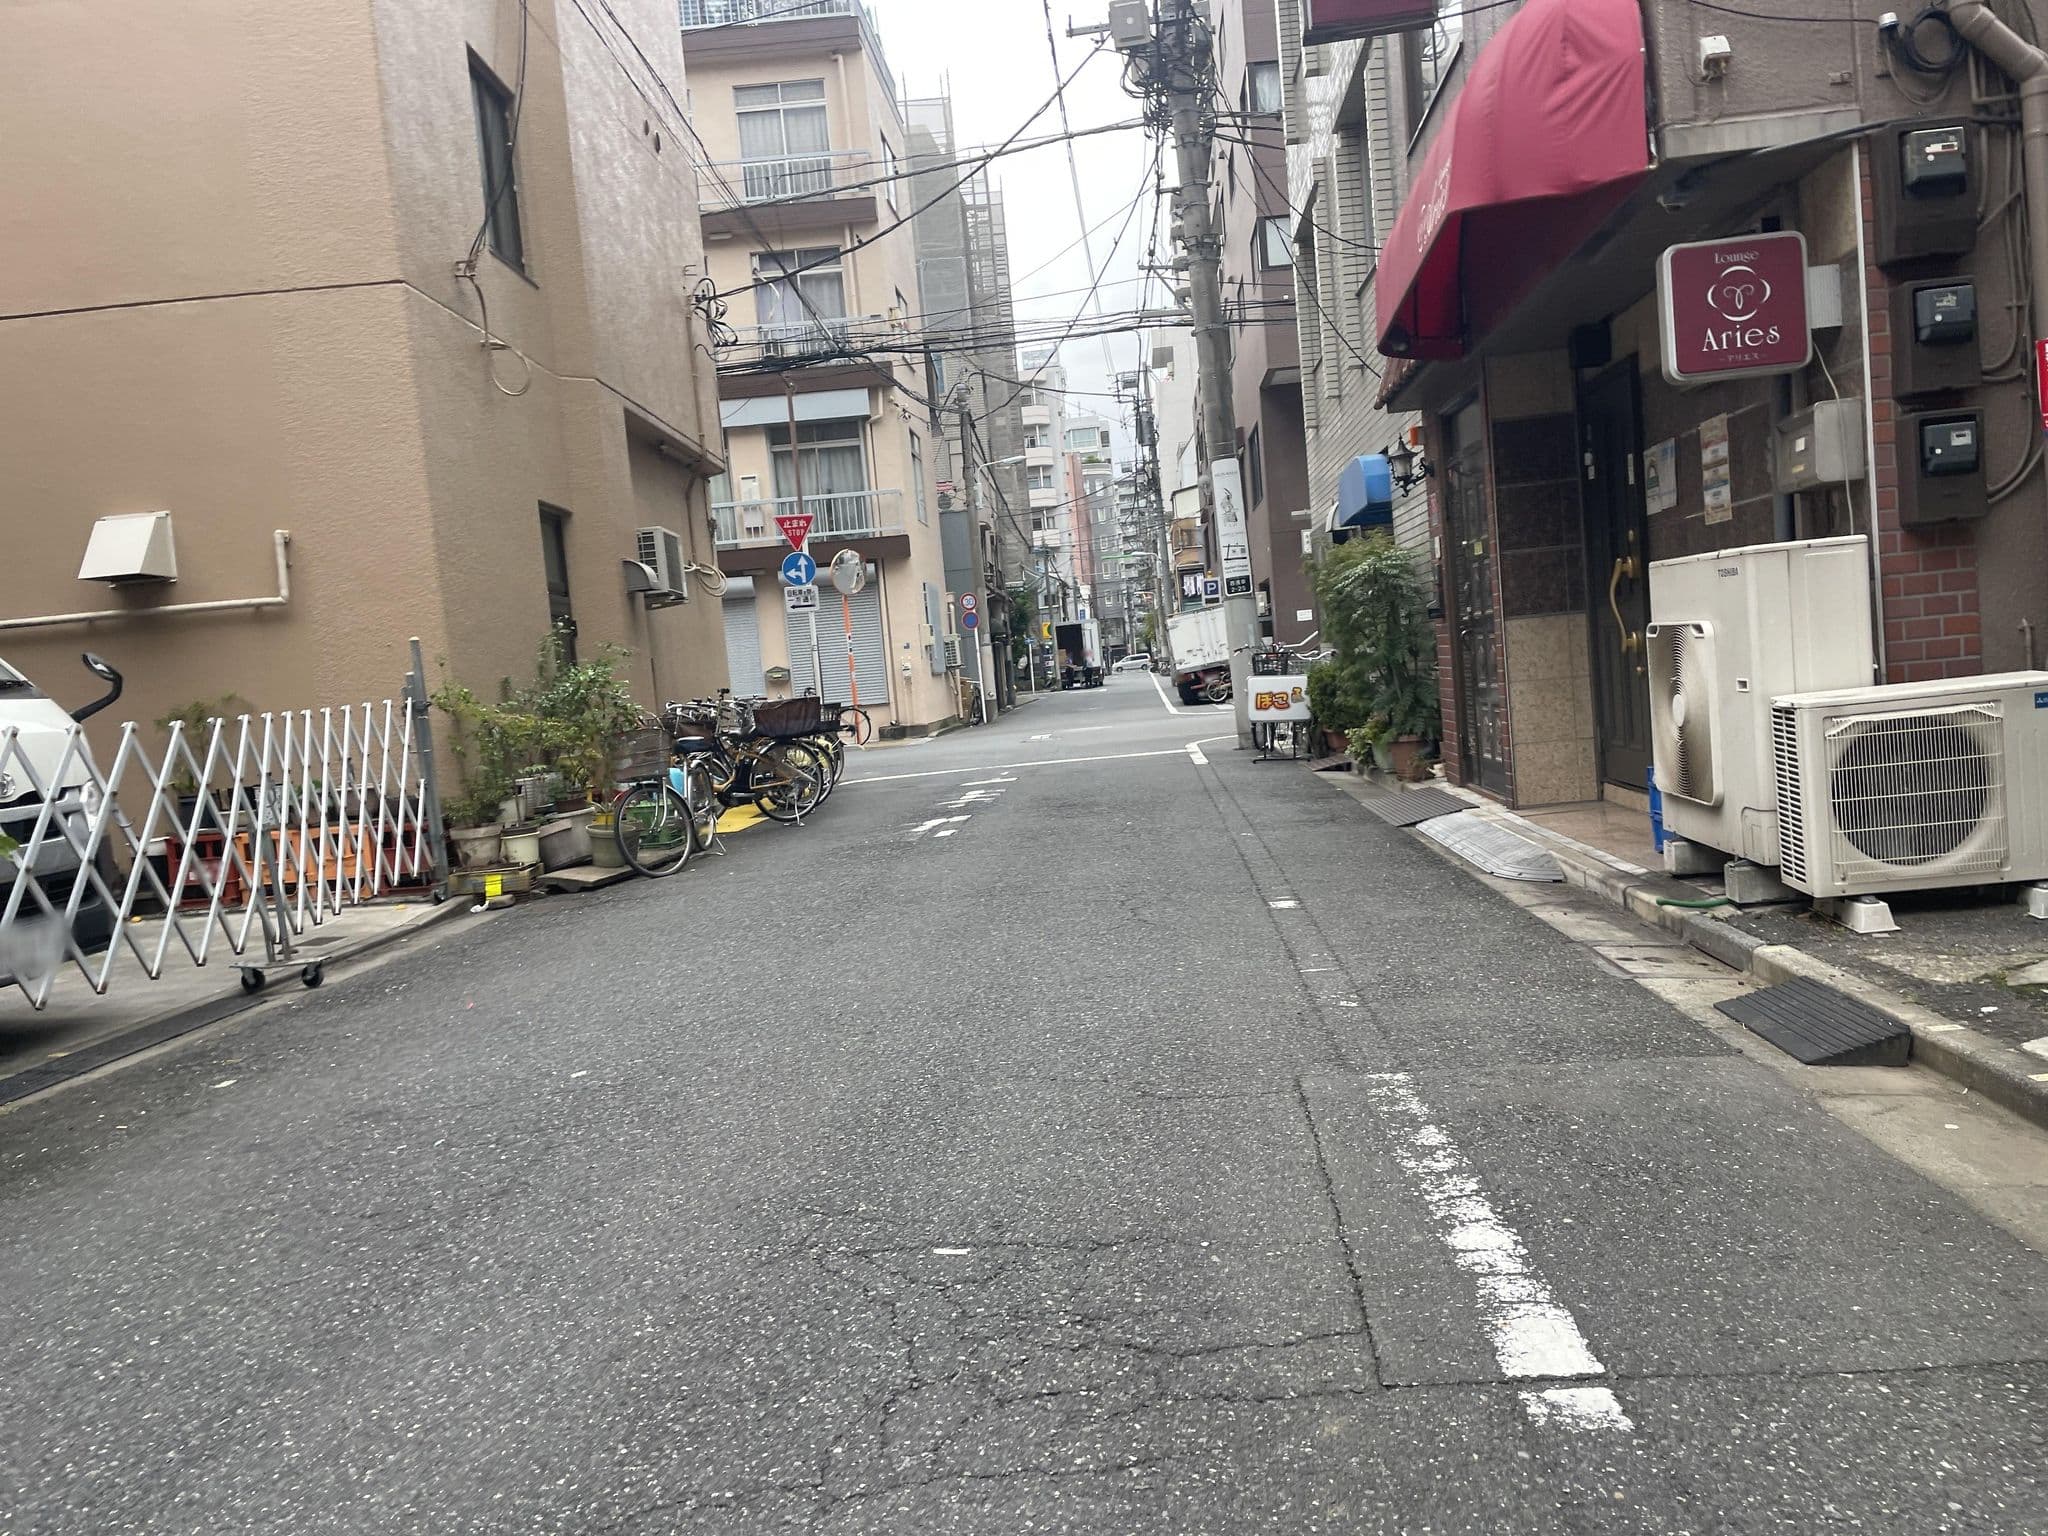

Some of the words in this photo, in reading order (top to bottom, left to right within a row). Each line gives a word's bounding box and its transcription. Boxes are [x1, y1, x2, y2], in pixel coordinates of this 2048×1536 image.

[1714, 250, 1760, 264] Lounge
[1702, 324, 1780, 351] Aries
[783, 519, 807, 528] 止まれ
[788, 529, 805, 537] STOP
[1206, 582, 1217, 594] P
